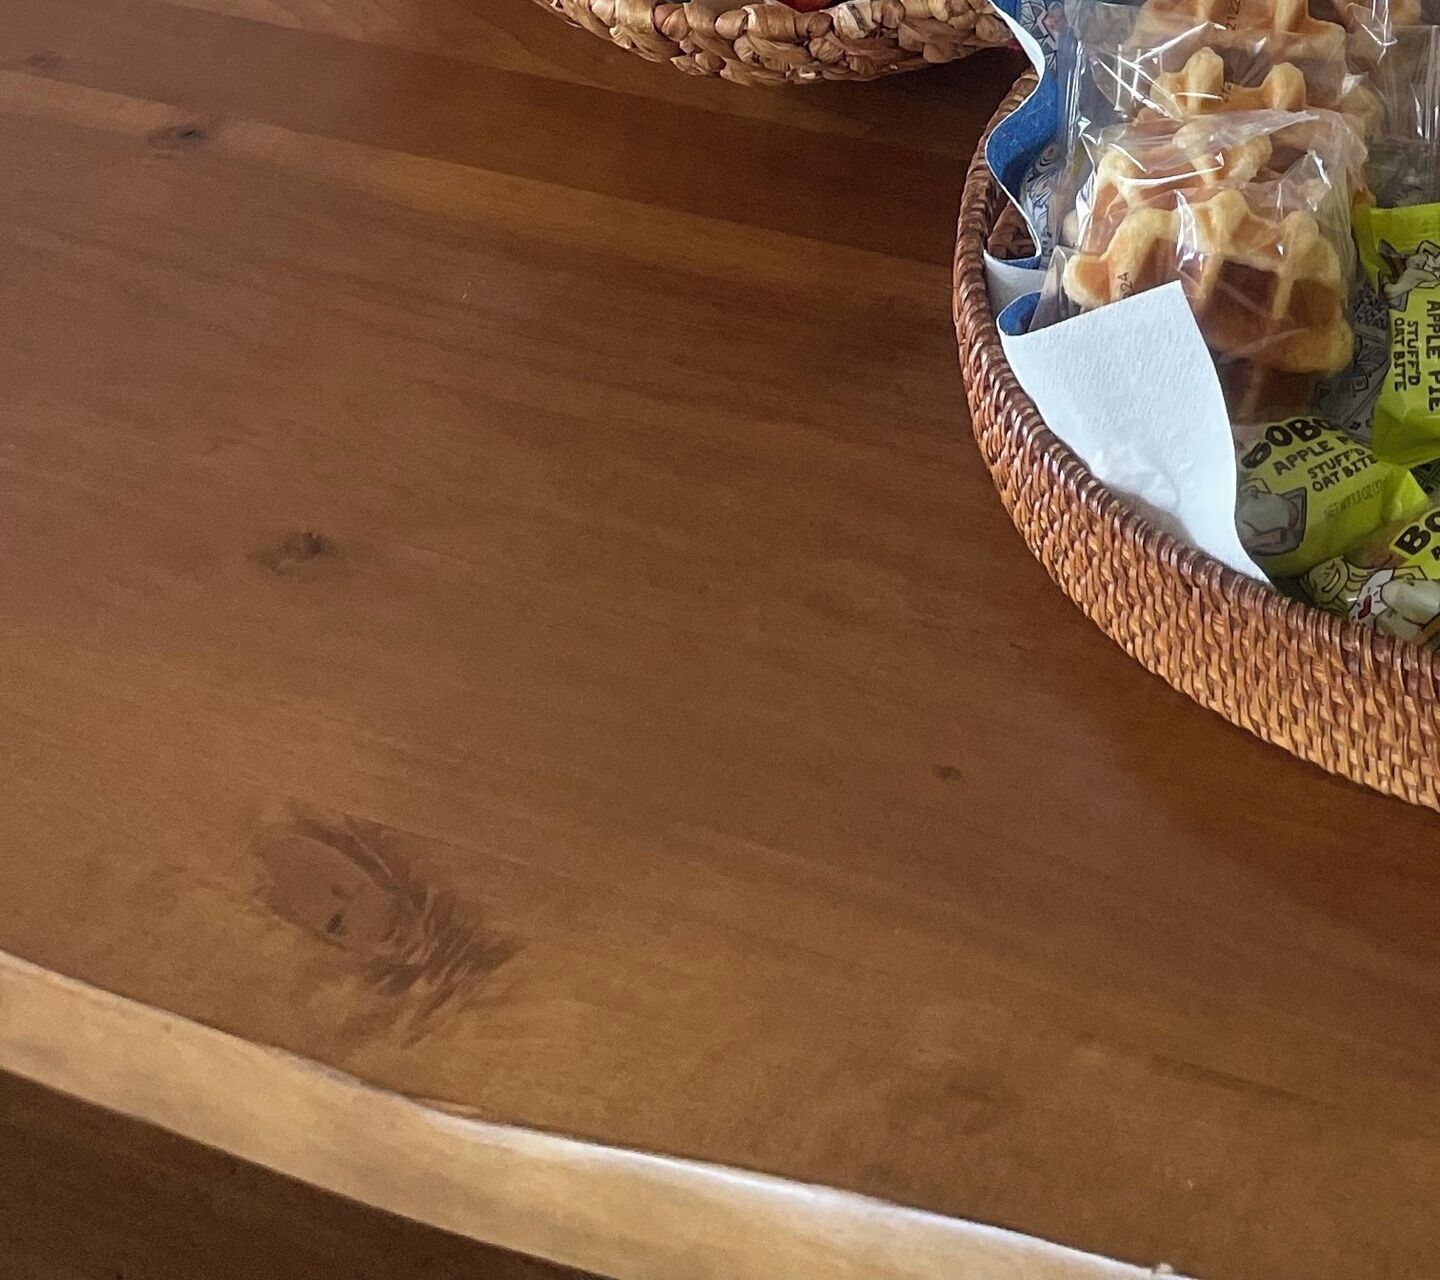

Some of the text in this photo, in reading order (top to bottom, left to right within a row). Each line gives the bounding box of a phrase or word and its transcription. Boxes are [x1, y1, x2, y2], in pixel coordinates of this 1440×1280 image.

[1393, 317, 1407, 392] OAT BITE
[1407, 320, 1421, 386] STUFF'D
[1272, 440, 1336, 476] APPLE
[1307, 448, 1366, 479] STUFF'D
[1312, 473, 1342, 492] OAT
